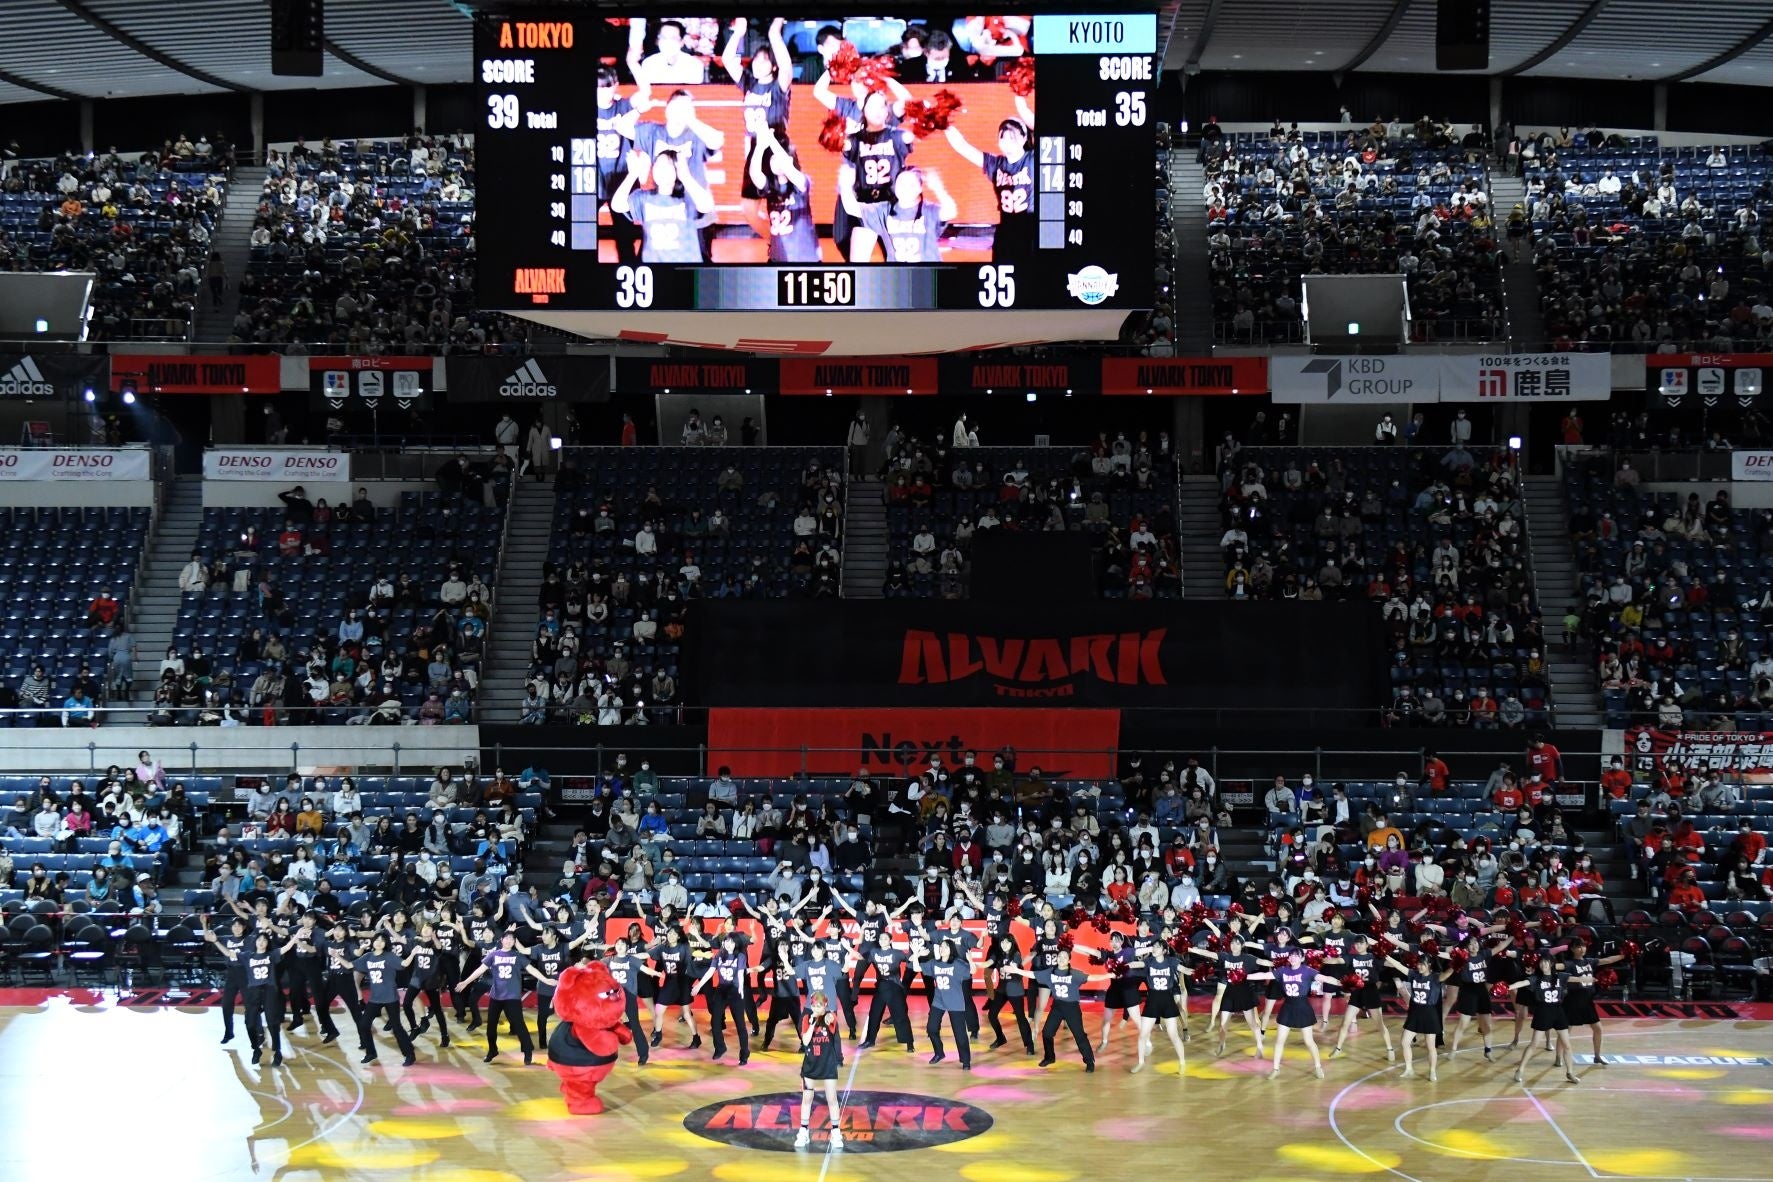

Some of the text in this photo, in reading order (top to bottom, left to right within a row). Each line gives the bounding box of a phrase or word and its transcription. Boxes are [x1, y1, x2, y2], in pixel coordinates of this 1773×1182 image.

[500, 22, 574, 48] A TOKYO
[1069, 21, 1124, 44] KYOTO
[482, 59, 535, 84] SCORE
[1099, 56, 1152, 81] SCORE
[488, 94, 557, 129] 39 Total
[1076, 91, 1146, 127] Total 35
[551, 139, 595, 165] 1Q 20
[1041, 139, 1082, 165] 21 1Q
[551, 168, 595, 193] 2Q 19
[1042, 167, 1083, 192] 14 2Q
[551, 202, 565, 219] 3Q
[1069, 200, 1083, 217] 3Q
[551, 231, 565, 247] 4Q
[1069, 229, 1083, 245] 4Q
[515, 268, 566, 293] ALVARK
[616, 265, 653, 307] 39
[784, 271, 851, 305] 11:50
[978, 264, 1015, 307] 35
[1348, 359, 1385, 374] KBD
[1479, 356, 1570, 367] 100年をつくる会社
[148, 363, 245, 386] ALVARK TOKYO
[650, 365, 746, 388] ALVARK TOKYO
[814, 365, 910, 388] ALVARK TOKYO
[972, 365, 1068, 388] ALVARK TOKYO
[1137, 365, 1233, 388] ALVARK TOKYO
[1514, 369, 1570, 397] 鹿島
[0, 380, 54, 395] adidas
[499, 382, 557, 398] adidas
[1348, 379, 1413, 395] GROUP
[52, 455, 114, 467] DENSO
[219, 456, 272, 467] DENSO
[285, 457, 337, 468] DENSO
[898, 627, 1168, 685] ALVARK
[994, 683, 1075, 698] TOKYO
[1684, 733, 1711, 741] PRIDE
[861, 733, 964, 765] Next
[1601, 1002, 1740, 1019] OKYO
[811, 1131, 875, 1142] OYO
